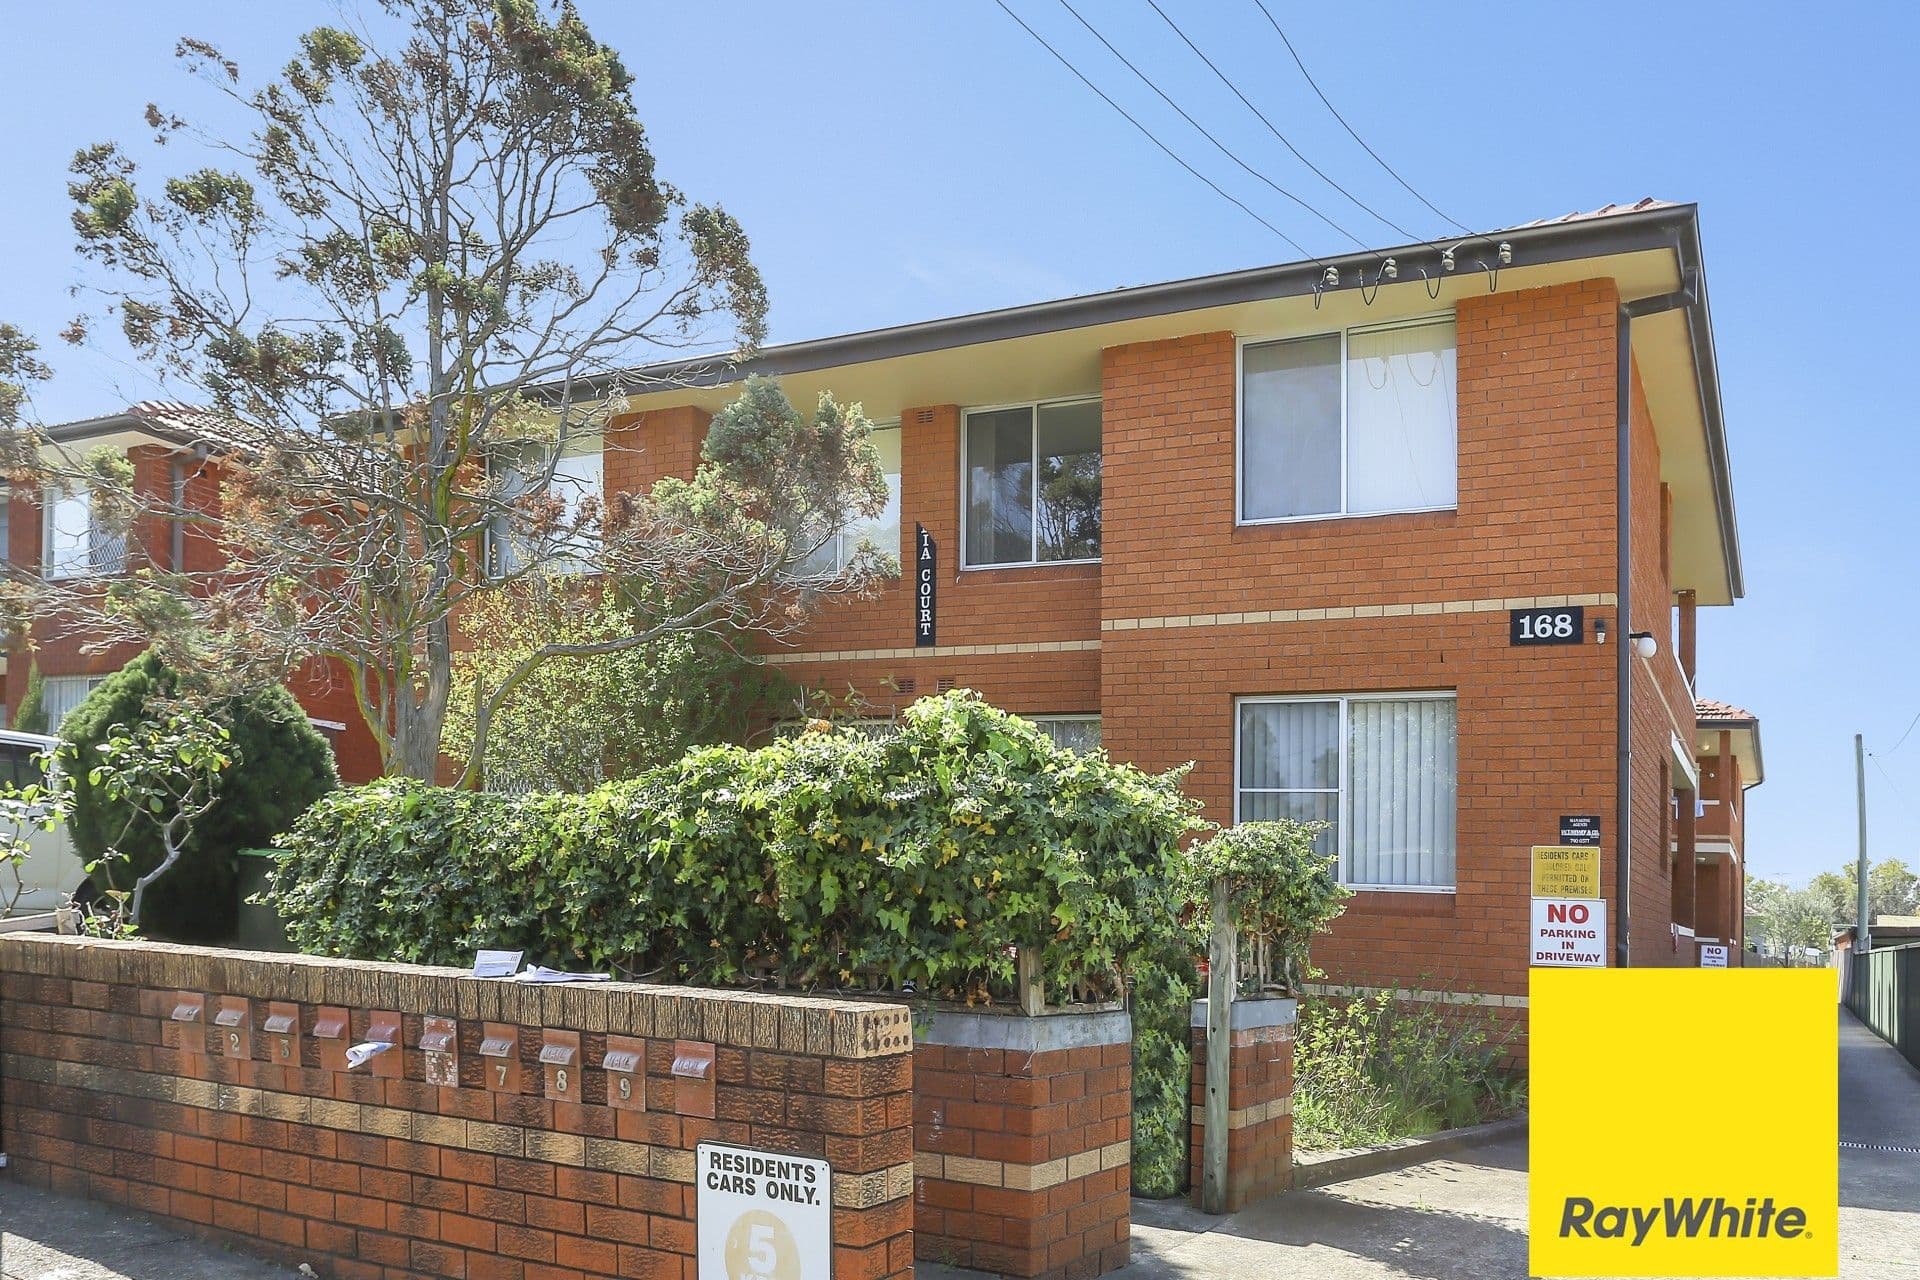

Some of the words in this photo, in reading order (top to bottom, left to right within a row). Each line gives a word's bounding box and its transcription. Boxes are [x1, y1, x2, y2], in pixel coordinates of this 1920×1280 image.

[920, 568, 932, 636] COURT
[1519, 614, 1573, 639] 168
[1547, 903, 1589, 924] NO
[1540, 929, 1596, 939] PARKING
[1561, 941, 1575, 950] IN
[1536, 952, 1601, 963] DRIVEWAY
[1706, 947, 1722, 955] NO
[230, 1033, 241, 1057] 2
[495, 1065, 507, 1088] 7
[556, 1070, 568, 1092] 8
[620, 1078, 632, 1101] 9
[709, 1151, 817, 1184] RESIDENTS
[706, 1171, 757, 1196] CARS
[765, 1181, 821, 1206] ONLY.
[747, 1223, 778, 1275] 5
